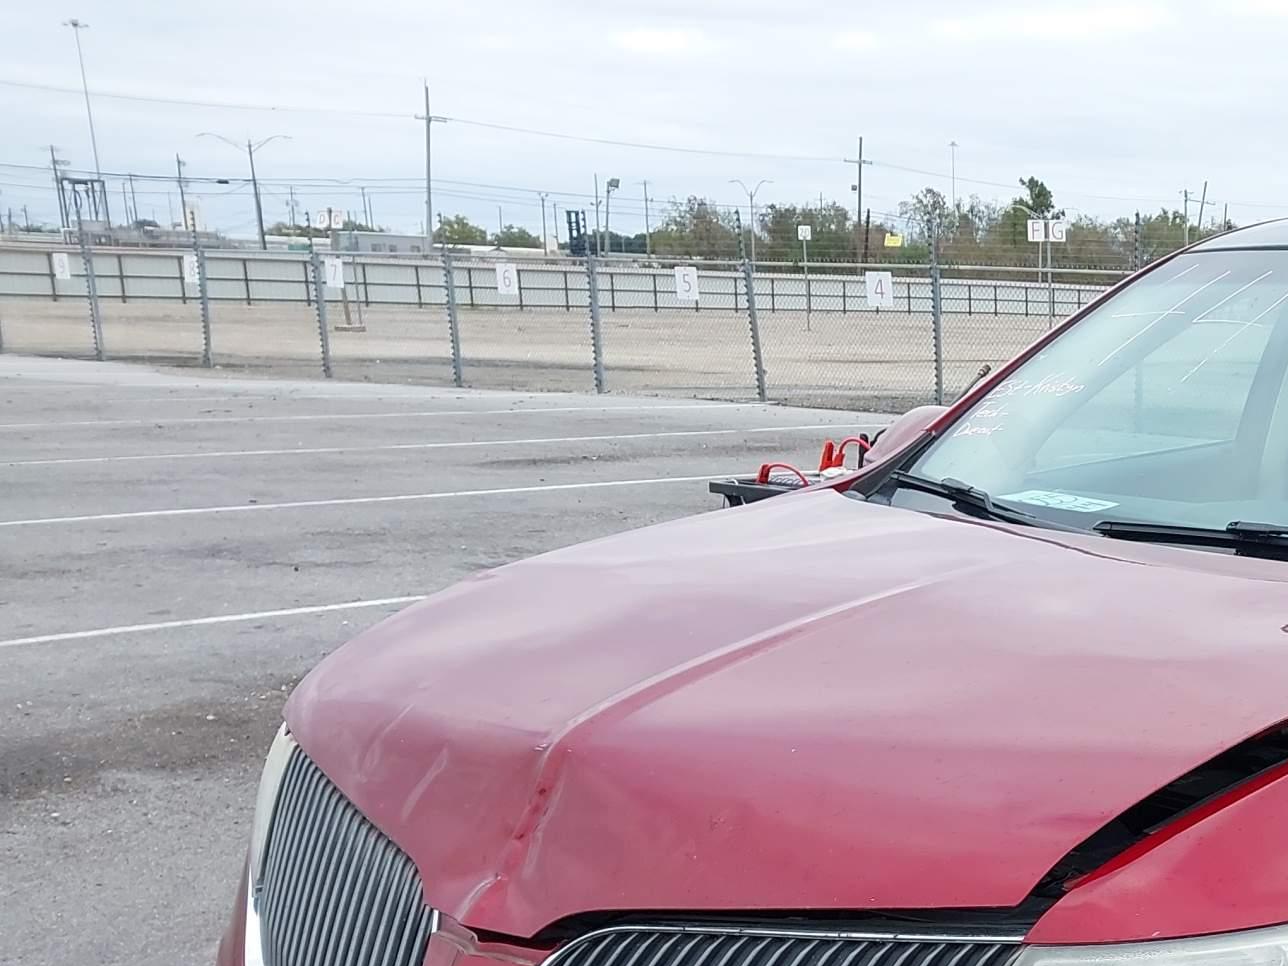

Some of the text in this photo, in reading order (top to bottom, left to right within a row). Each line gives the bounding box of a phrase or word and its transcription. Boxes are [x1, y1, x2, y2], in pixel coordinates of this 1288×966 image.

[1031, 221, 1041, 241] F
[1051, 221, 1064, 241] G
[502, 268, 512, 289] 6
[681, 274, 692, 293] 5
[873, 279, 886, 300] 4
